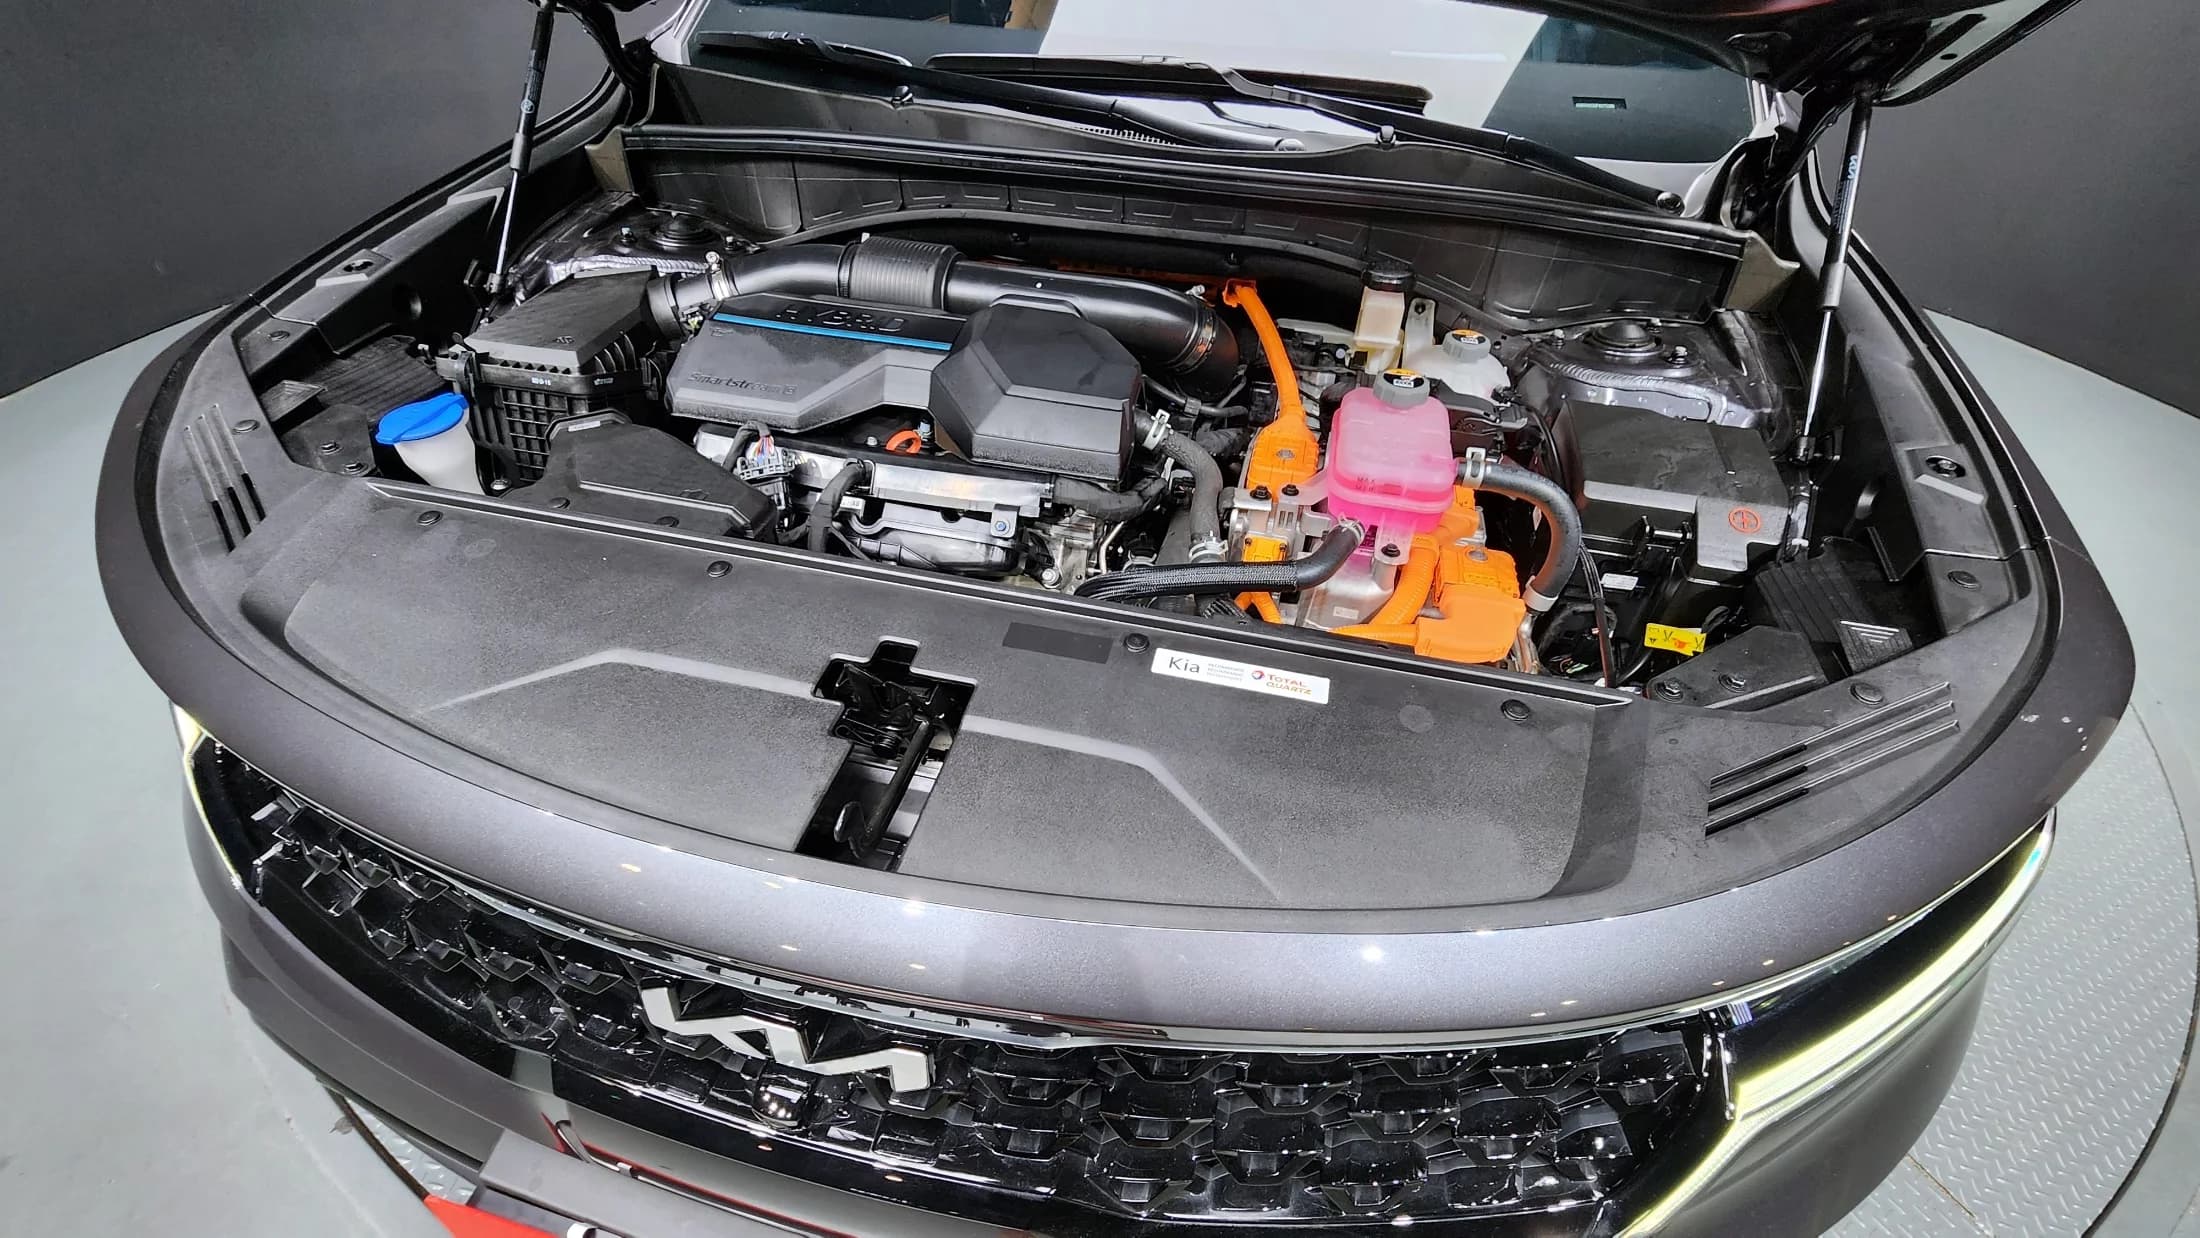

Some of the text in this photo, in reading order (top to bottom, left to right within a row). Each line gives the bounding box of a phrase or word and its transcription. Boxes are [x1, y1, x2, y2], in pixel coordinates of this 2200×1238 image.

[1168, 656, 1200, 674] Kia
[1265, 681, 1312, 696] QUARTZ
[1267, 674, 1308, 688] TOTAL
